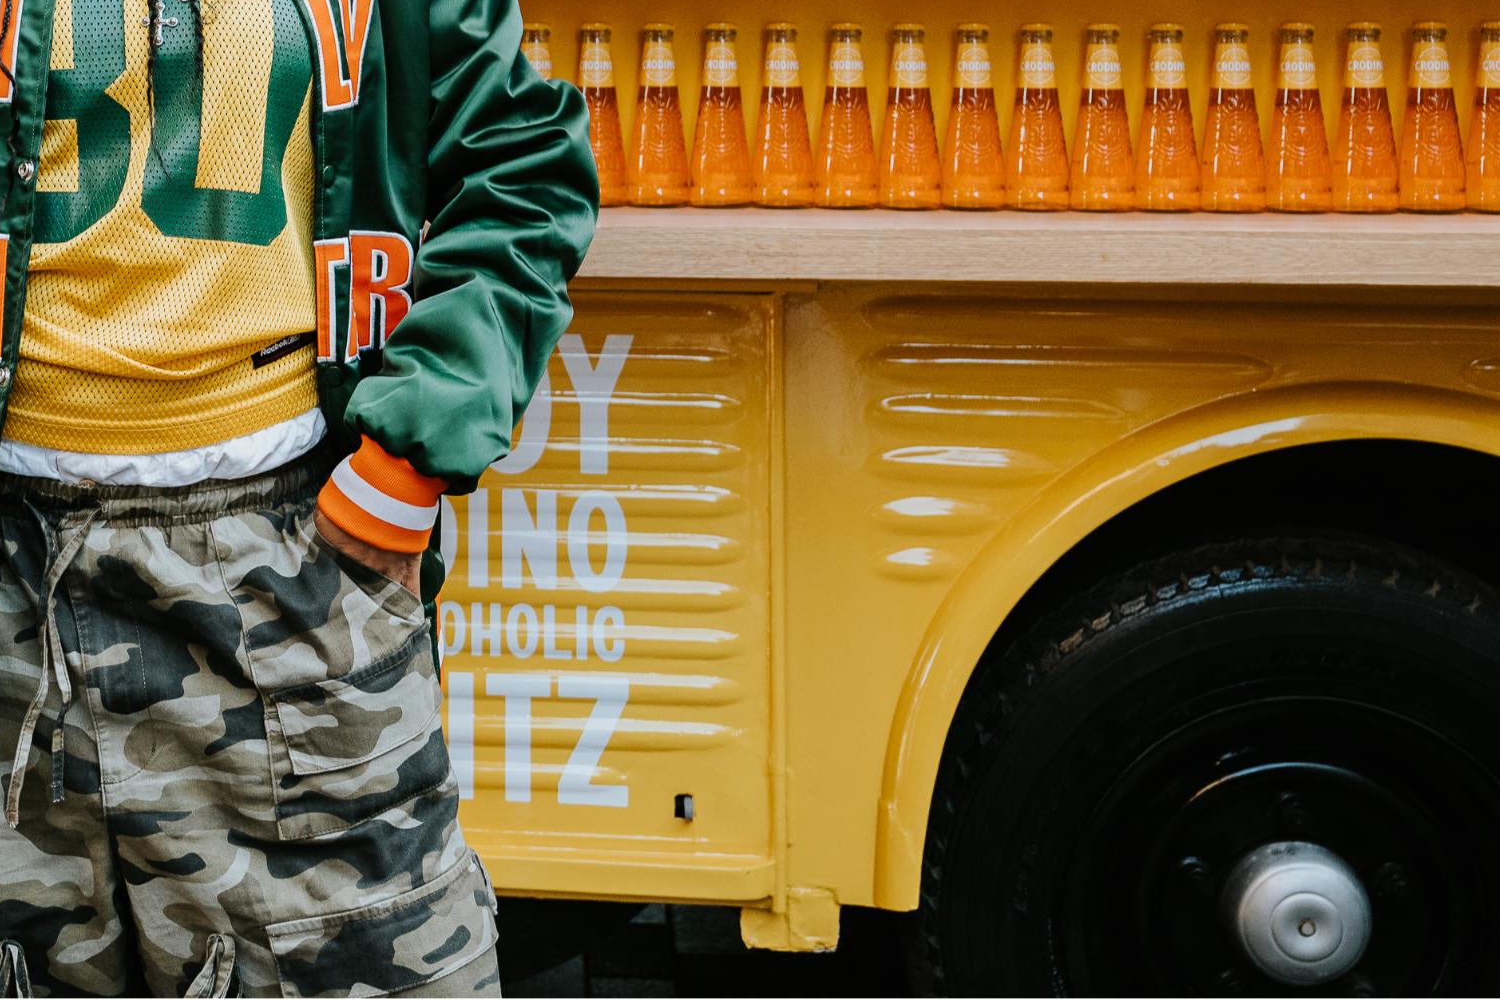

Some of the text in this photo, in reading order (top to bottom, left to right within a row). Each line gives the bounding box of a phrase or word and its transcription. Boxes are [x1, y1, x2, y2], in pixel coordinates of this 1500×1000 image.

[958, 60, 991, 72] CRODIN
[1021, 61, 1055, 72] CRODIN
[1086, 61, 1122, 72] CRODIN
[1150, 61, 1185, 72] CRODIN
[1216, 61, 1252, 72] CRODIN
[1280, 61, 1316, 72] CRODIN
[1348, 60, 1384, 71] CRODIN
[1415, 60, 1450, 72] CRODIN
[260, 339, 288, 357] Reebok
